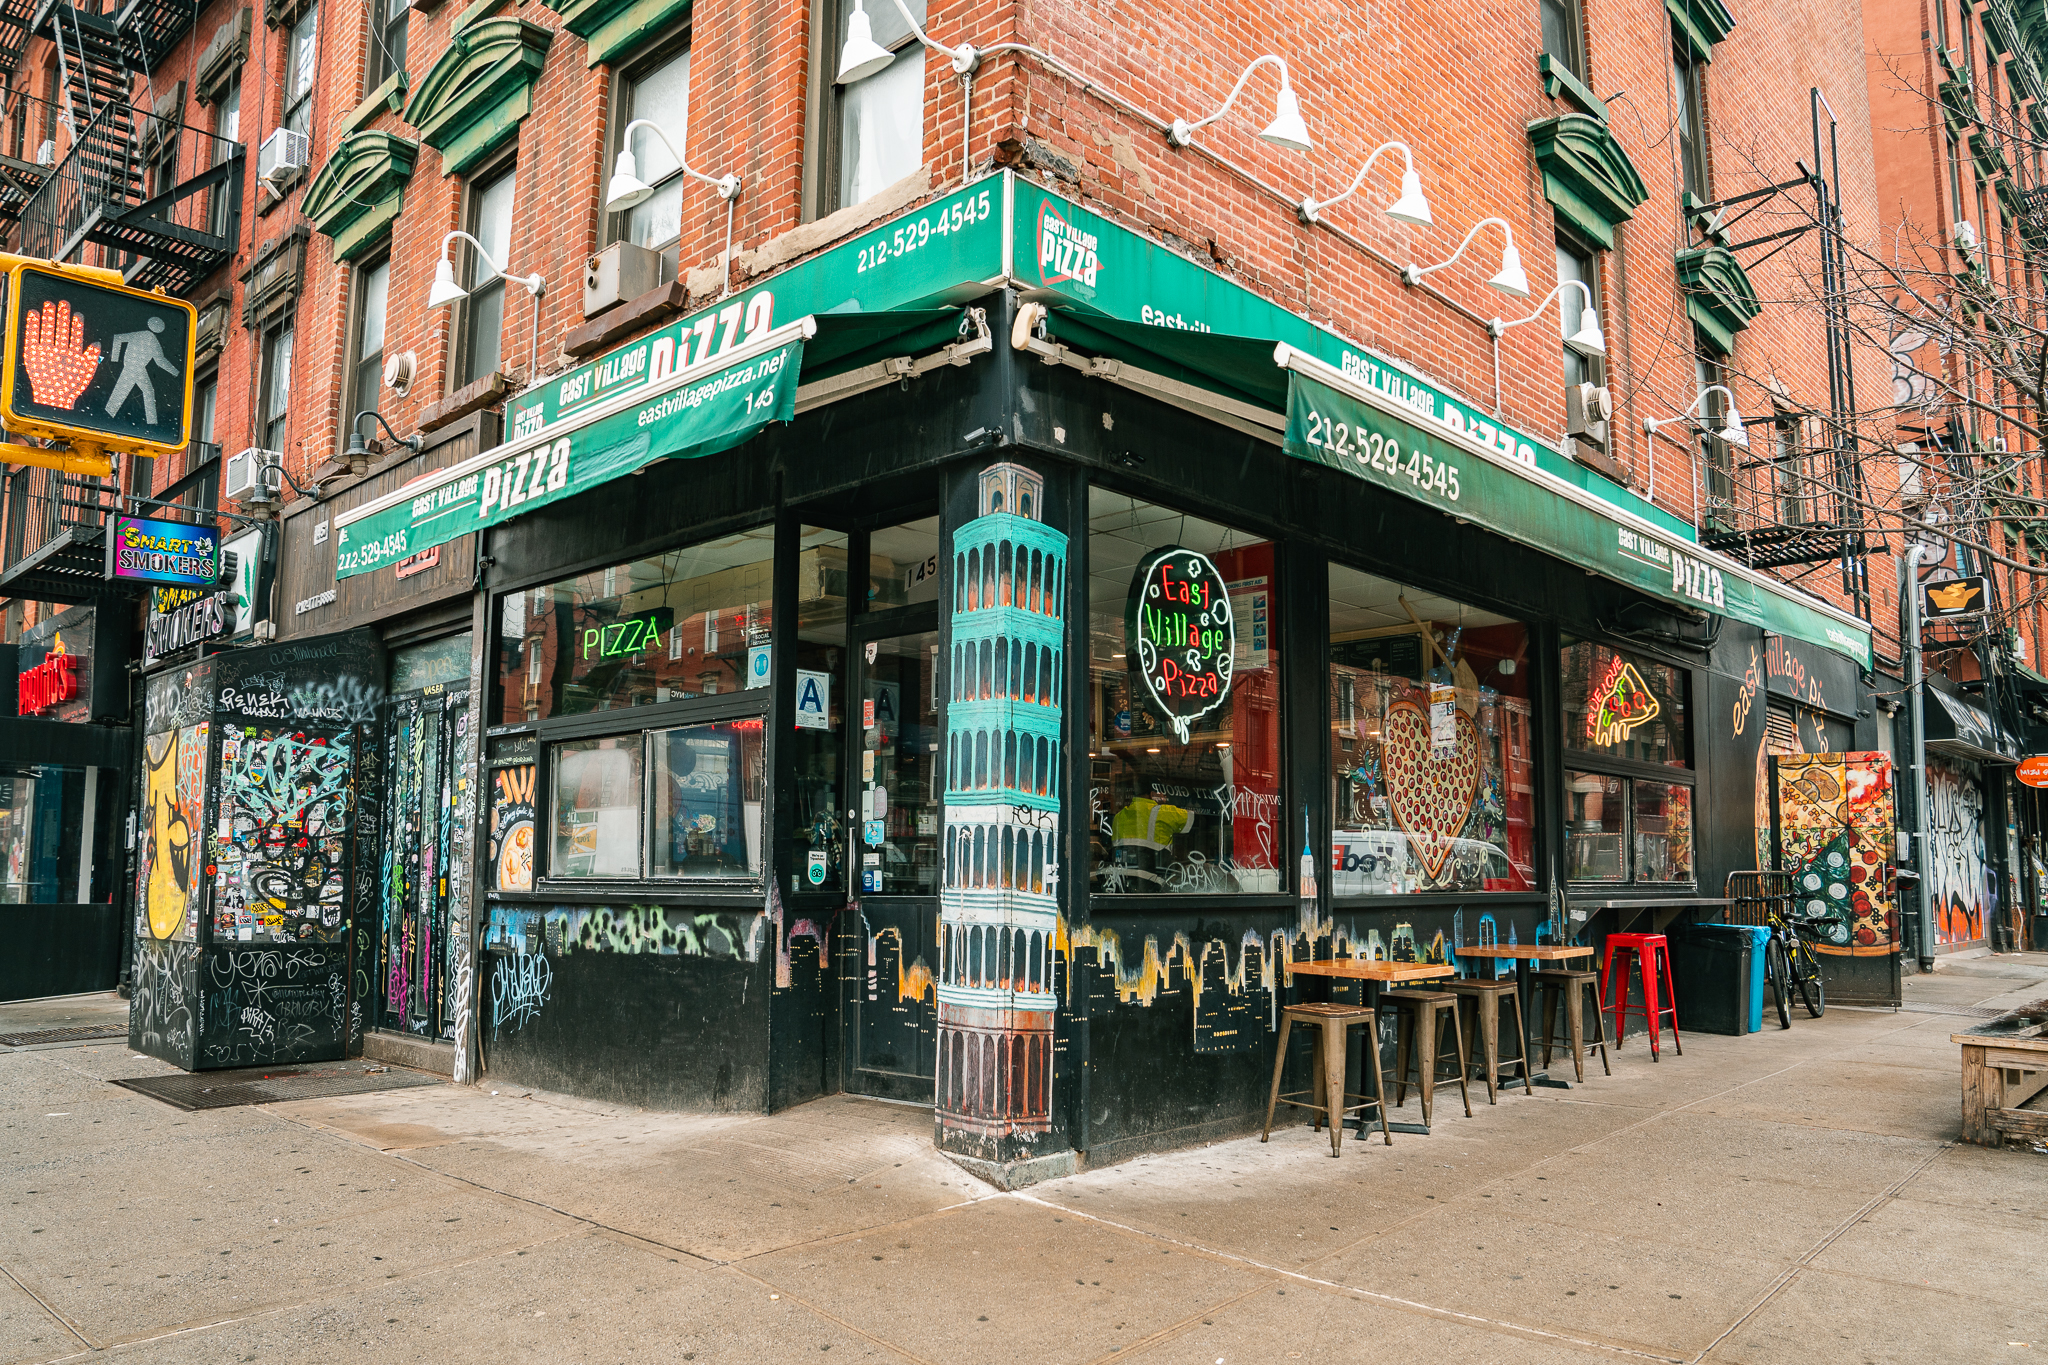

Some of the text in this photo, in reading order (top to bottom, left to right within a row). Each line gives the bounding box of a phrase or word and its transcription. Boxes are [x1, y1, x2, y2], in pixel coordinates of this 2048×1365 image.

[857, 189, 990, 274] 212-529-4545
[1041, 229, 1098, 288] pizza
[637, 349, 788, 427] eastvillagepizza.net
[744, 384, 776, 415] 145
[478, 437, 572, 519] pizza
[1306, 411, 1460, 501] 212-529-4545
[124, 526, 193, 555] SMART
[337, 529, 407, 571] 212-529-4545
[118, 549, 215, 579] SMOKERS
[908, 554, 936, 588] 145
[1162, 564, 1210, 610] East
[1672, 550, 1726, 610] pizza
[146, 590, 227, 659] SMOKERS
[583, 616, 662, 660] PIZZA
[1144, 603, 1225, 660] Village
[799, 678, 823, 712] A
[1162, 658, 1218, 697] Pizza
[1600, 654, 1624, 695] LOVE
[1586, 687, 1605, 738] TRUE
